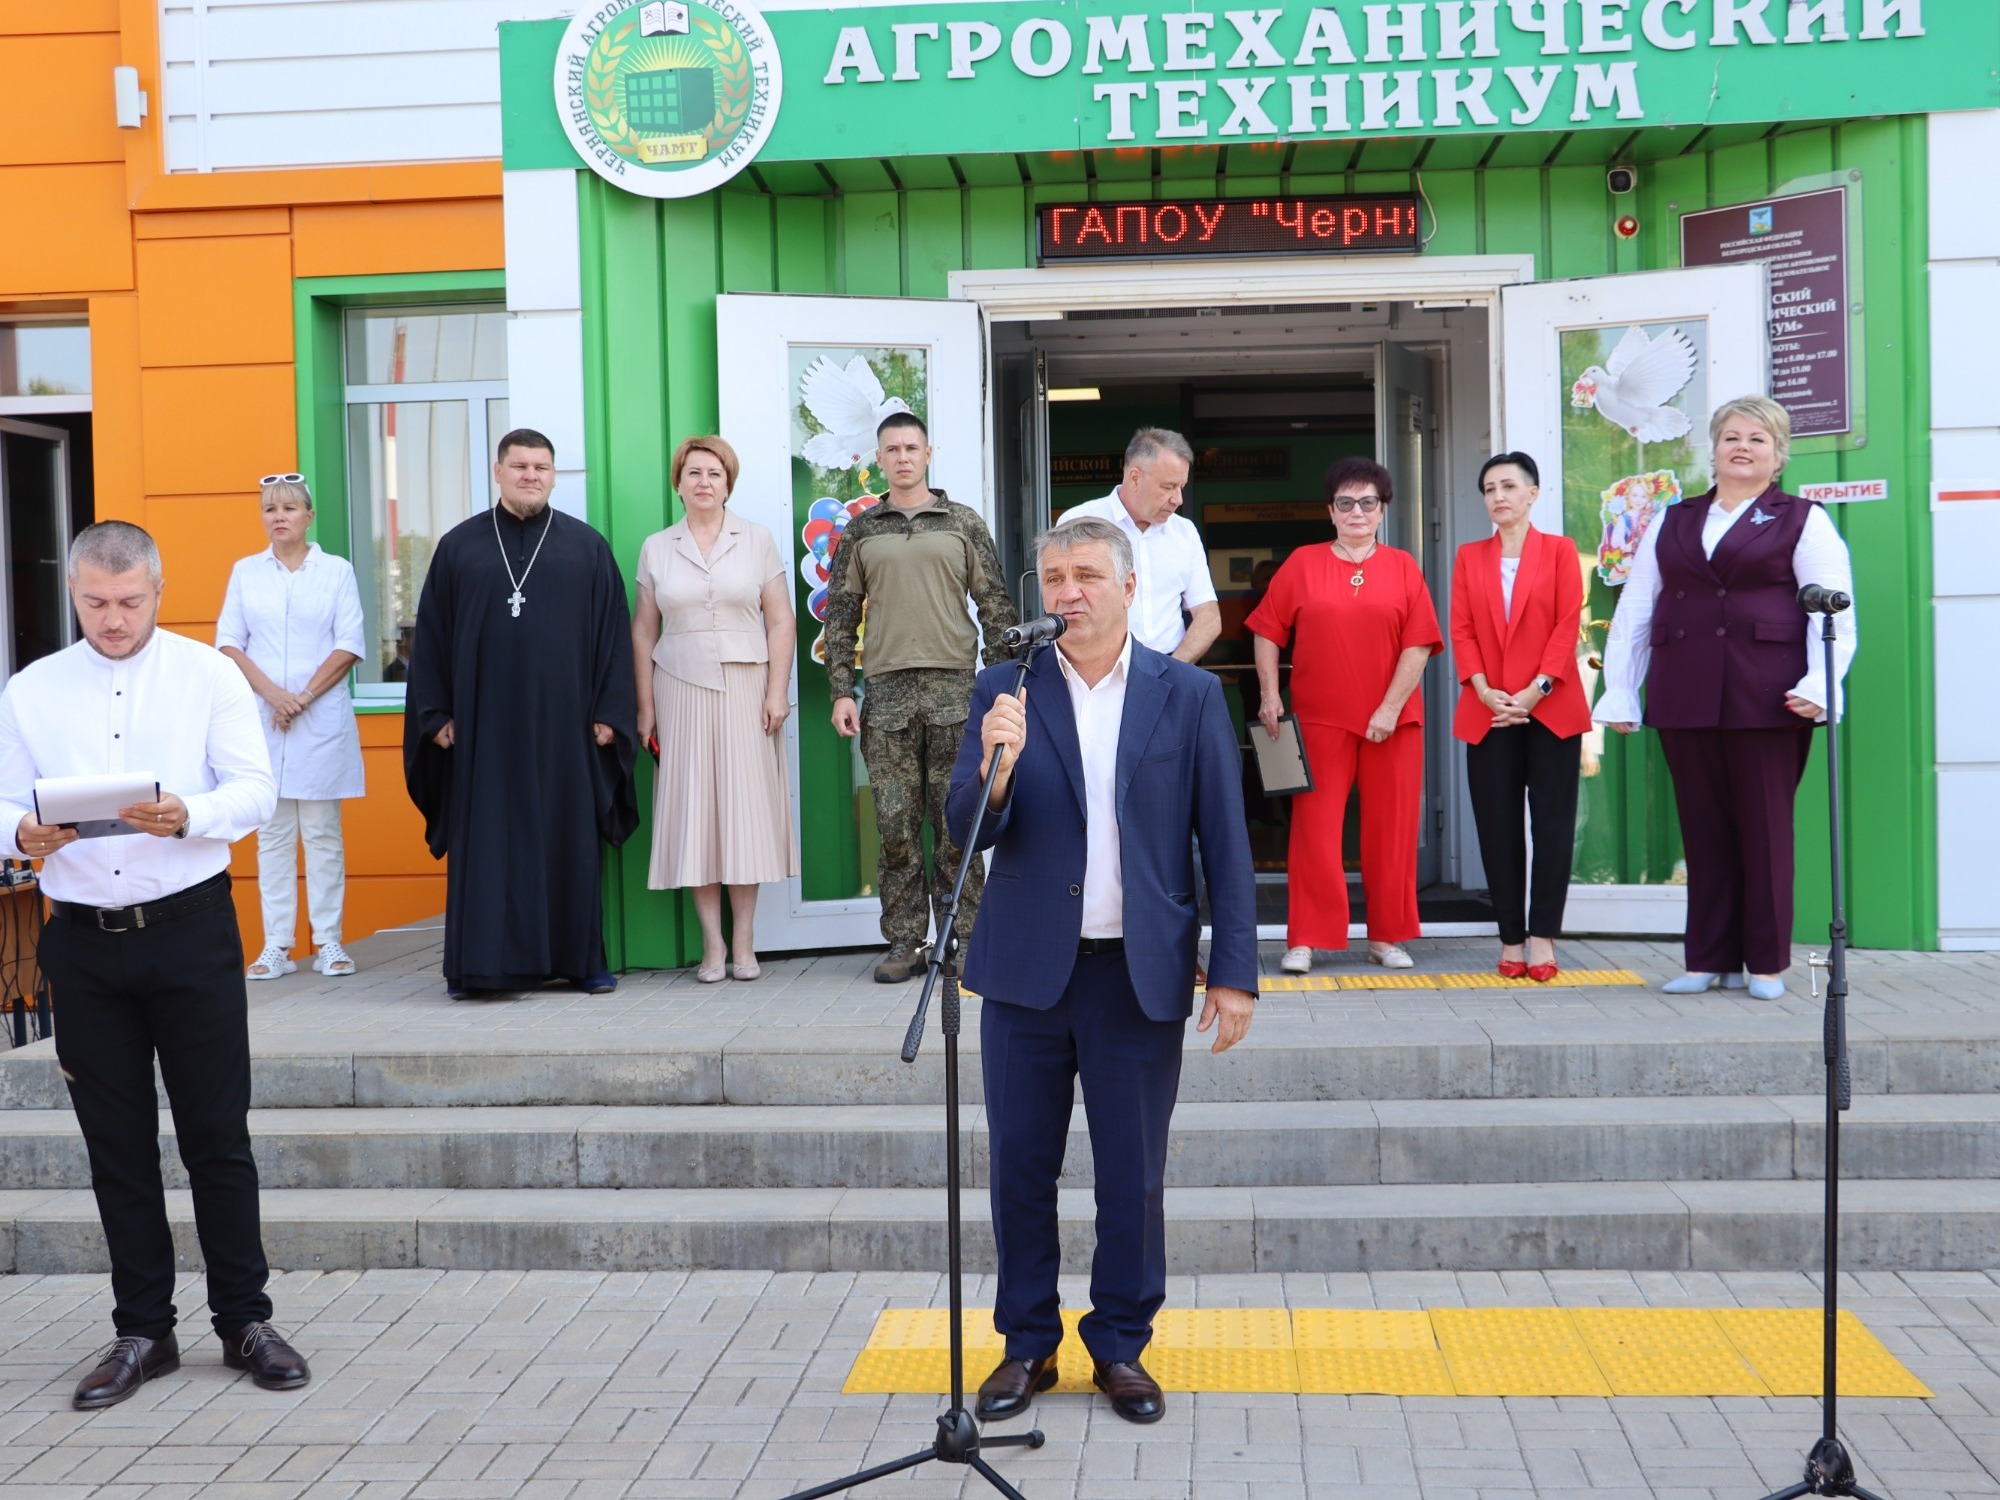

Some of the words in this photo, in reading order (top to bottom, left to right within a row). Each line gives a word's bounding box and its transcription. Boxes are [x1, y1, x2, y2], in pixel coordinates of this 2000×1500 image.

[568, 54, 626, 175] ЧЕРНЯНСКИЙ
[718, 62, 769, 167] ТЕХНИКУМ
[1094, 61, 1644, 140] ТЕХНИКУМ
[646, 142, 698, 156] ЧАМТ
[1053, 204, 1225, 244] ГАПОУ
[1772, 287, 1812, 304] СКИЙ
[1804, 483, 1882, 499] УКРЫТИЕ
